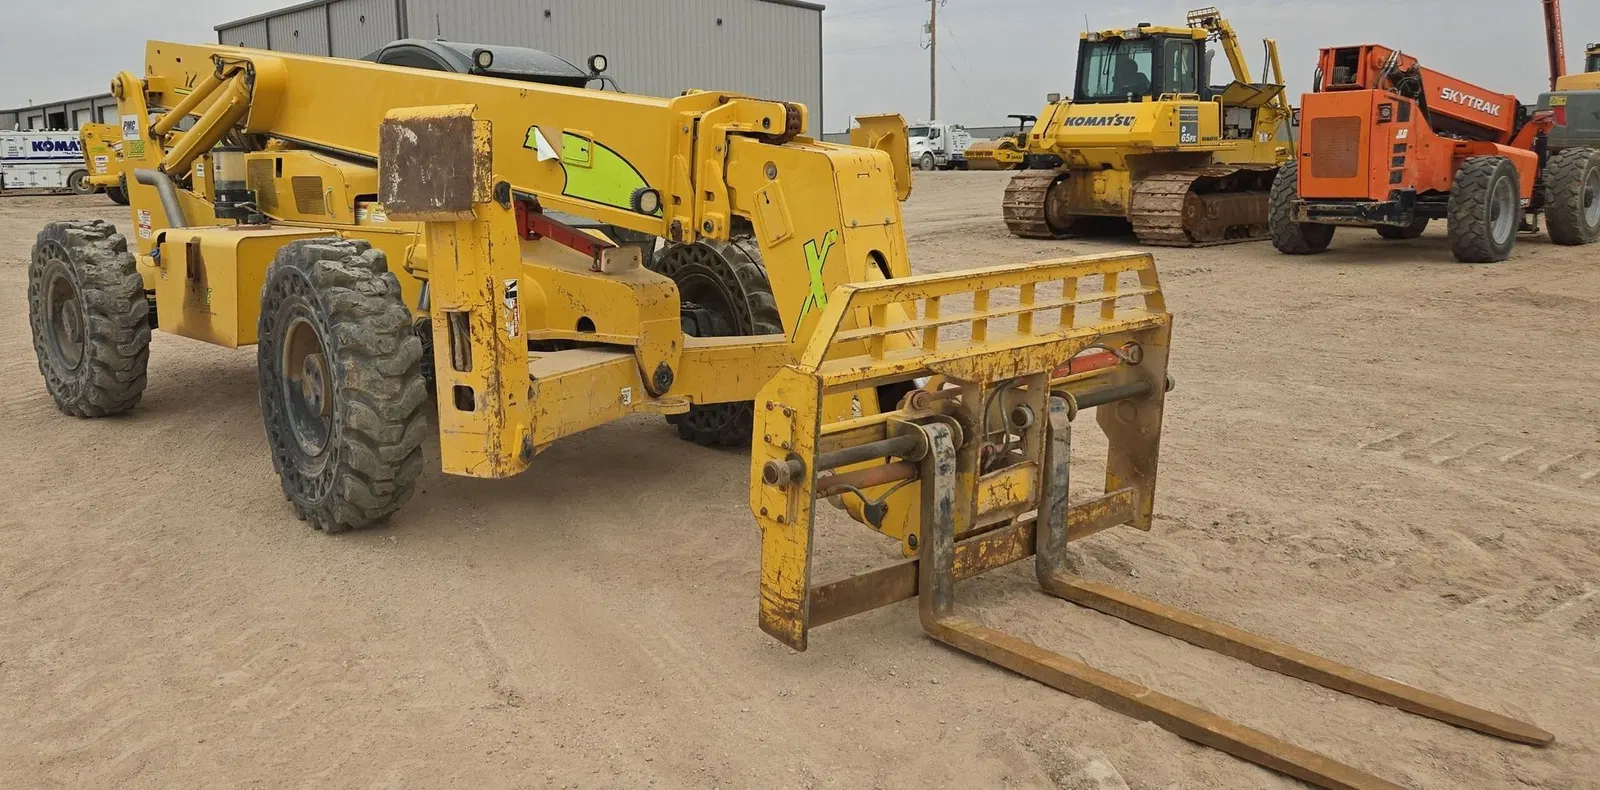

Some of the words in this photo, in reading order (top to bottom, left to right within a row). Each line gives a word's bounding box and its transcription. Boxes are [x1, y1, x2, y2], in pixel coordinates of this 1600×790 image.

[1440, 87, 1501, 117] SKYTRAK
[1064, 114, 1136, 127] KOMATSU
[1396, 128, 1408, 139] JLG
